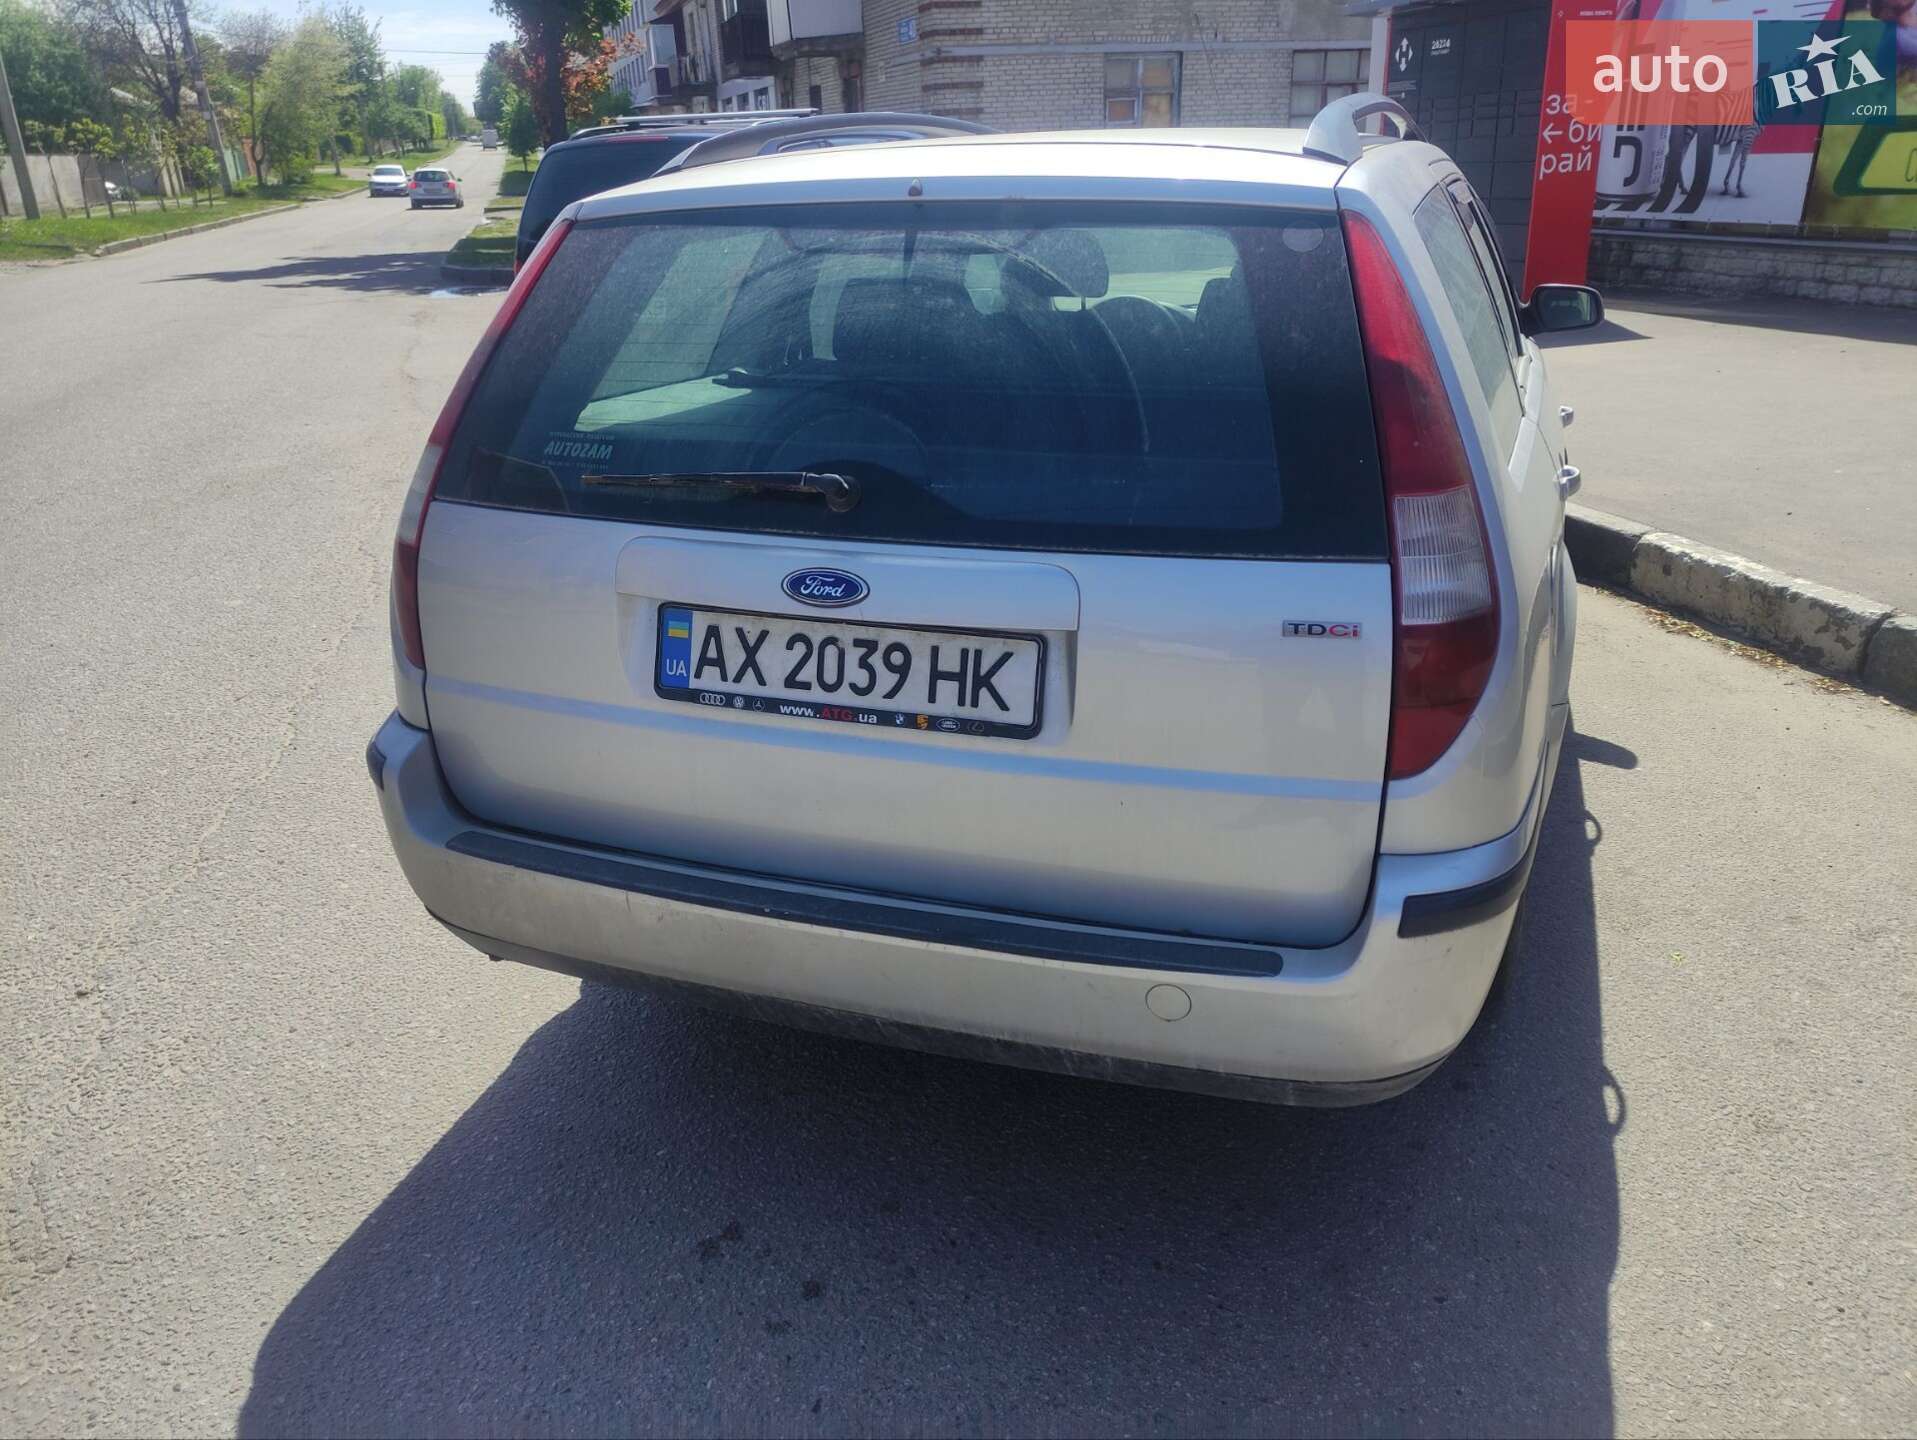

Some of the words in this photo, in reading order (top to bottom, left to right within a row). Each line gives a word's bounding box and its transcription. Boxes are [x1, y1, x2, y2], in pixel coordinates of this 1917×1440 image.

[1539, 145, 1593, 180] рай
[544, 440, 613, 460] AUTOZAM
[801, 575, 846, 597] Ford
[1287, 622, 1359, 637] TDCi
[666, 658, 687, 677] UA
[694, 624, 770, 686] AX
[784, 633, 912, 699] 2039
[928, 645, 1014, 712] HK
